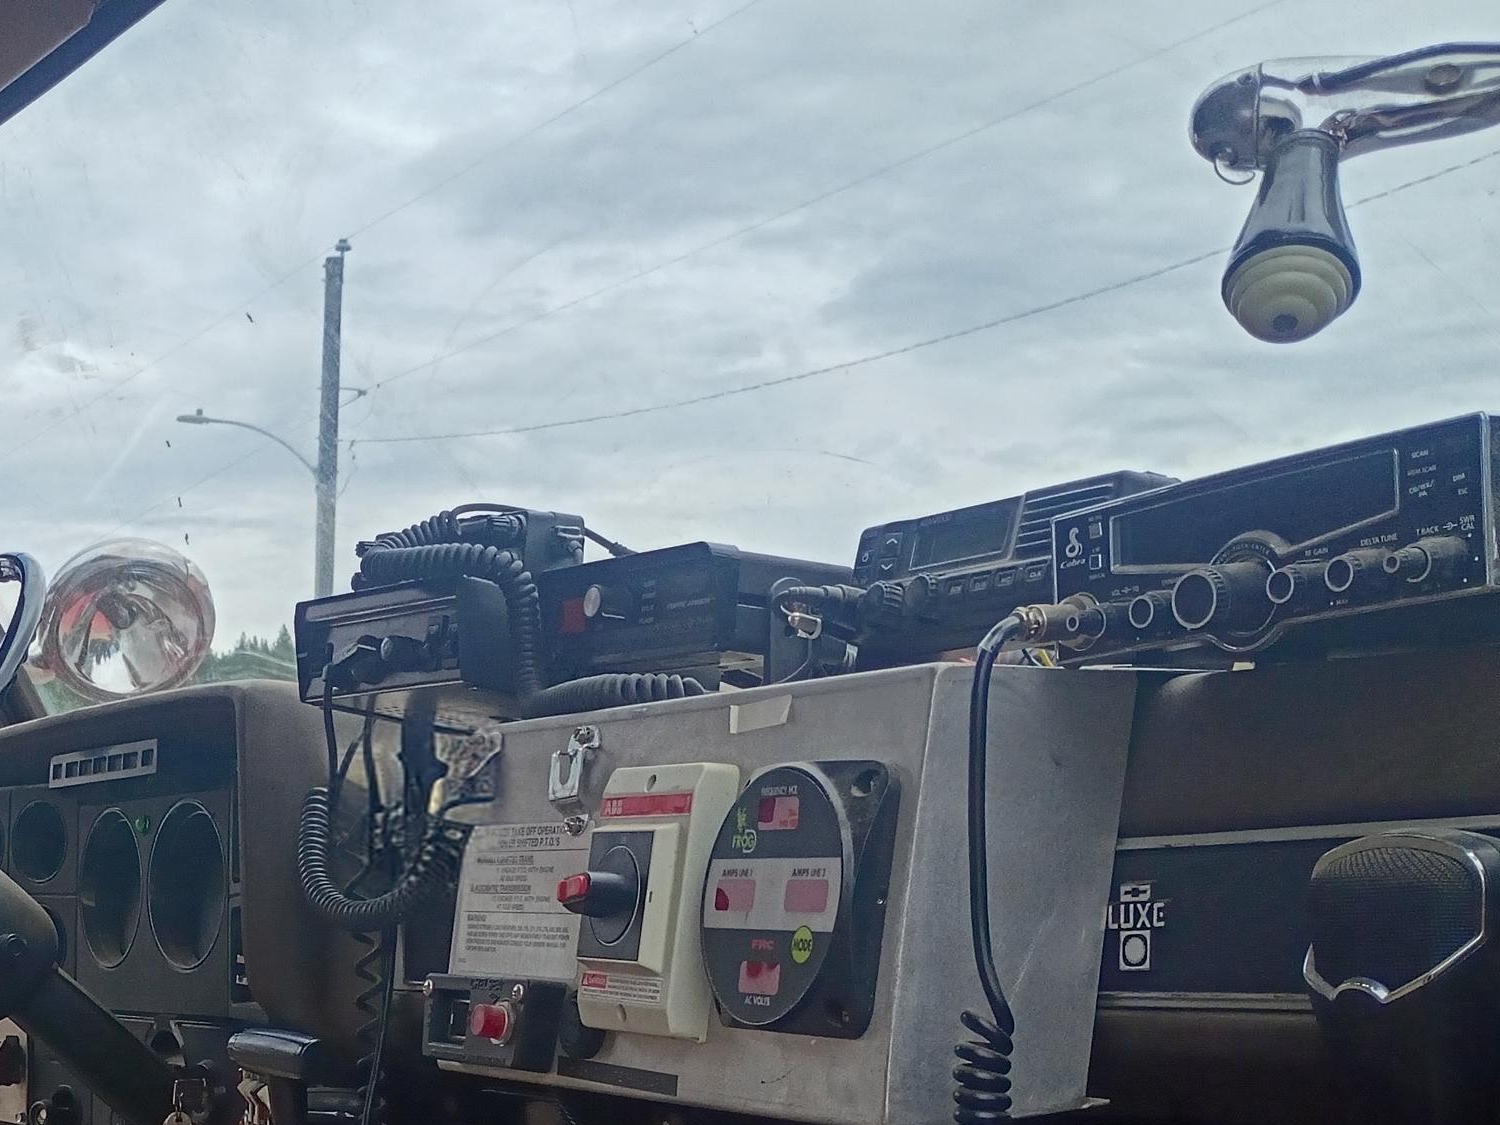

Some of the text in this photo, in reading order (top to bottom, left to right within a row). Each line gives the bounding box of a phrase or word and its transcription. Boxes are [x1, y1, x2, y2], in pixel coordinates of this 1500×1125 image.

[1060, 558, 1086, 569] Cobra
[603, 800, 623, 815] ABB
[526, 826, 537, 836] OFF
[722, 868, 738, 878] AMPS
[792, 868, 809, 877] AMPS
